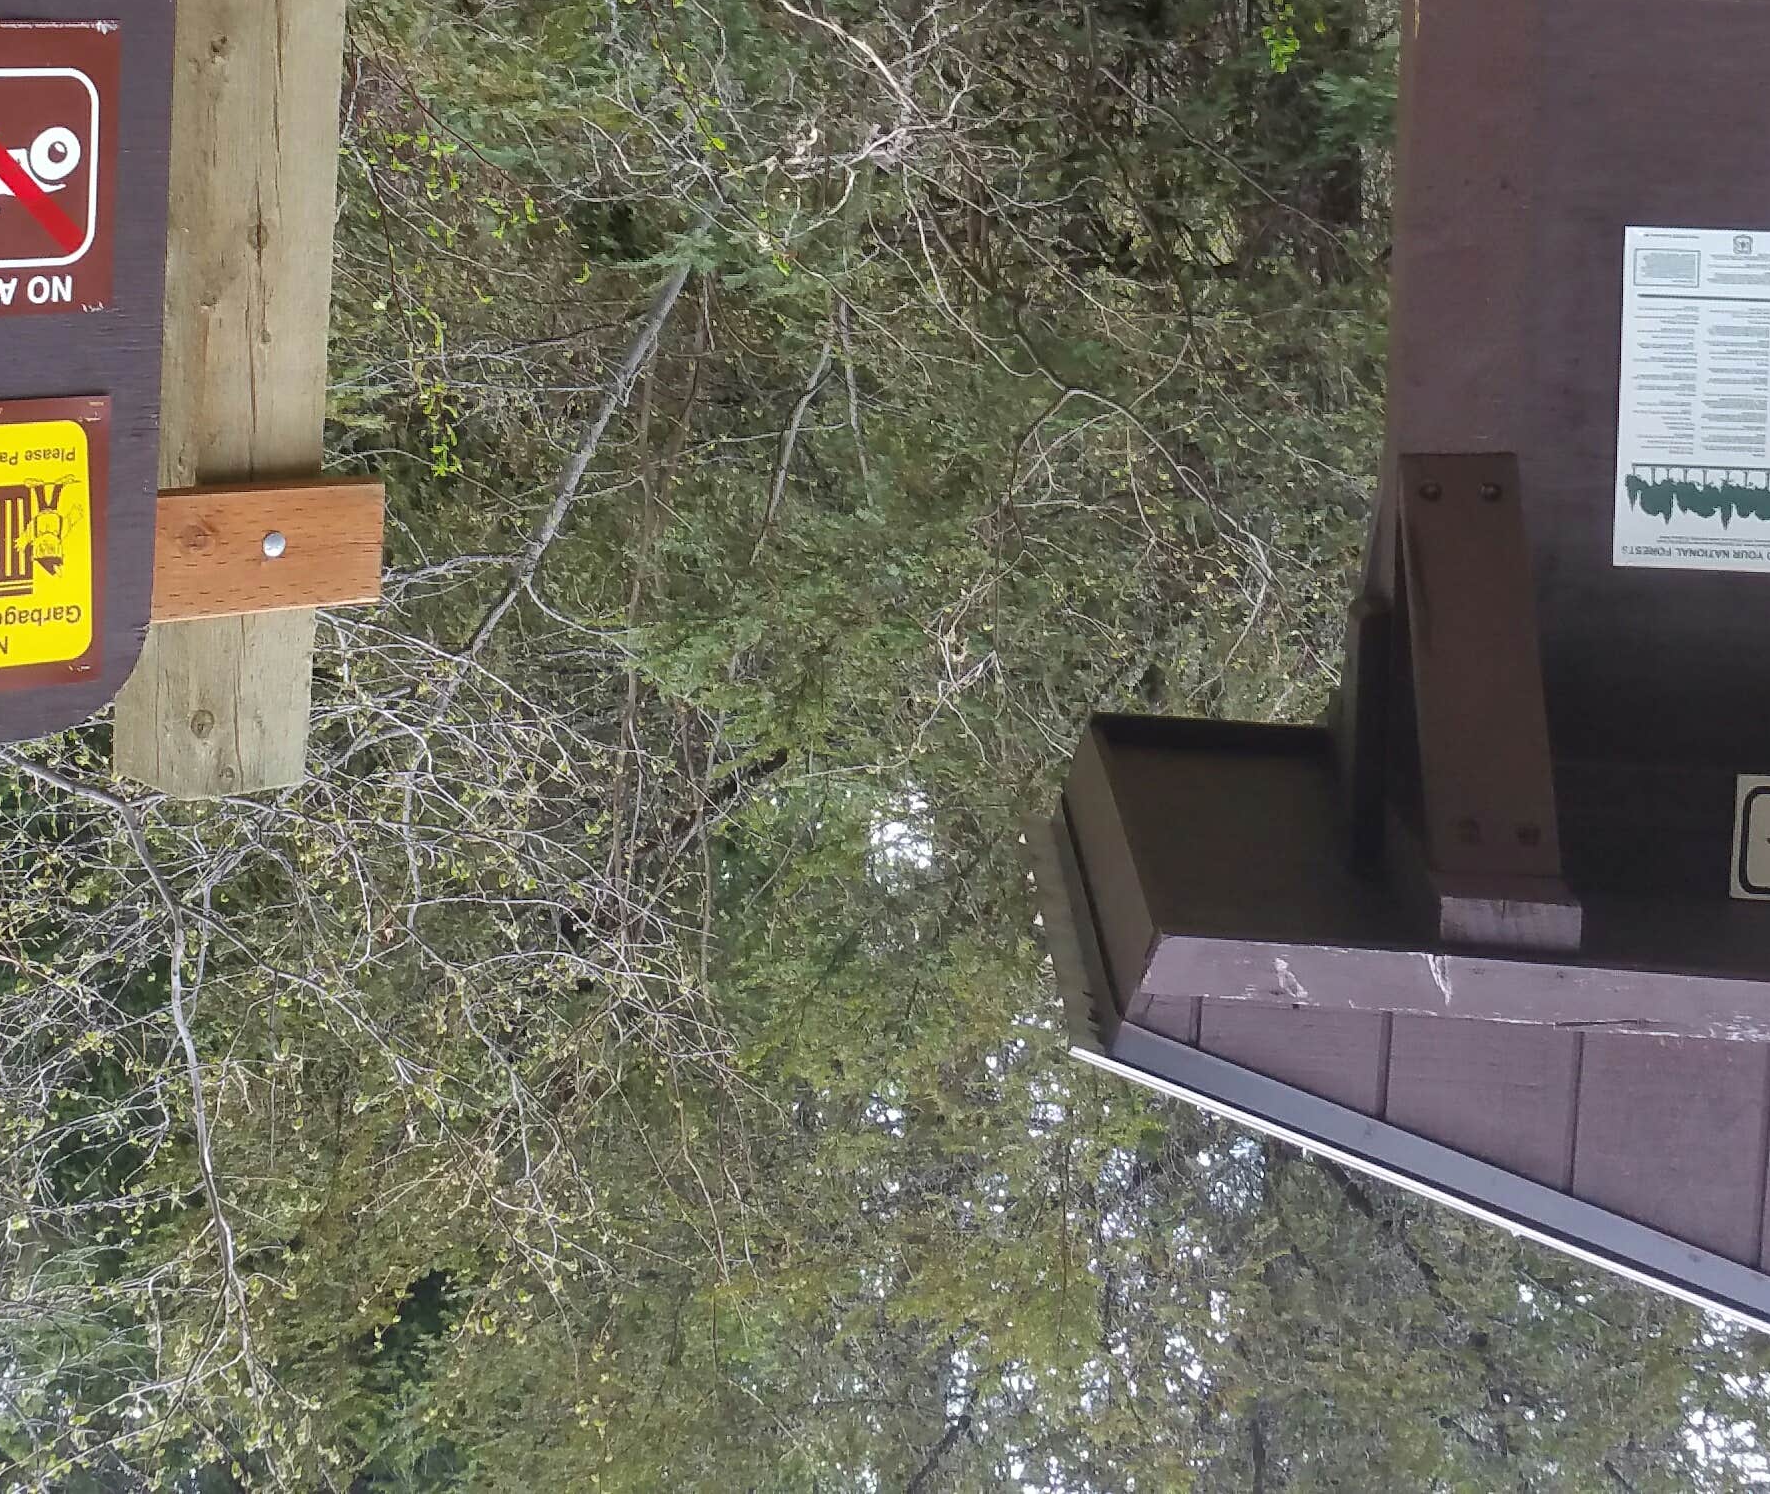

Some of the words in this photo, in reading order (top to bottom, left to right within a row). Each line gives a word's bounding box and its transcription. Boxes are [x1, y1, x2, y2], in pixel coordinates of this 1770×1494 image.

[27, 275, 73, 304] NO
[24, 447, 76, 463] Please
[1620, 545, 1672, 556] FORESTS
[1675, 548, 1730, 558] NATIONAL
[1732, 549, 1763, 559] YOUR
